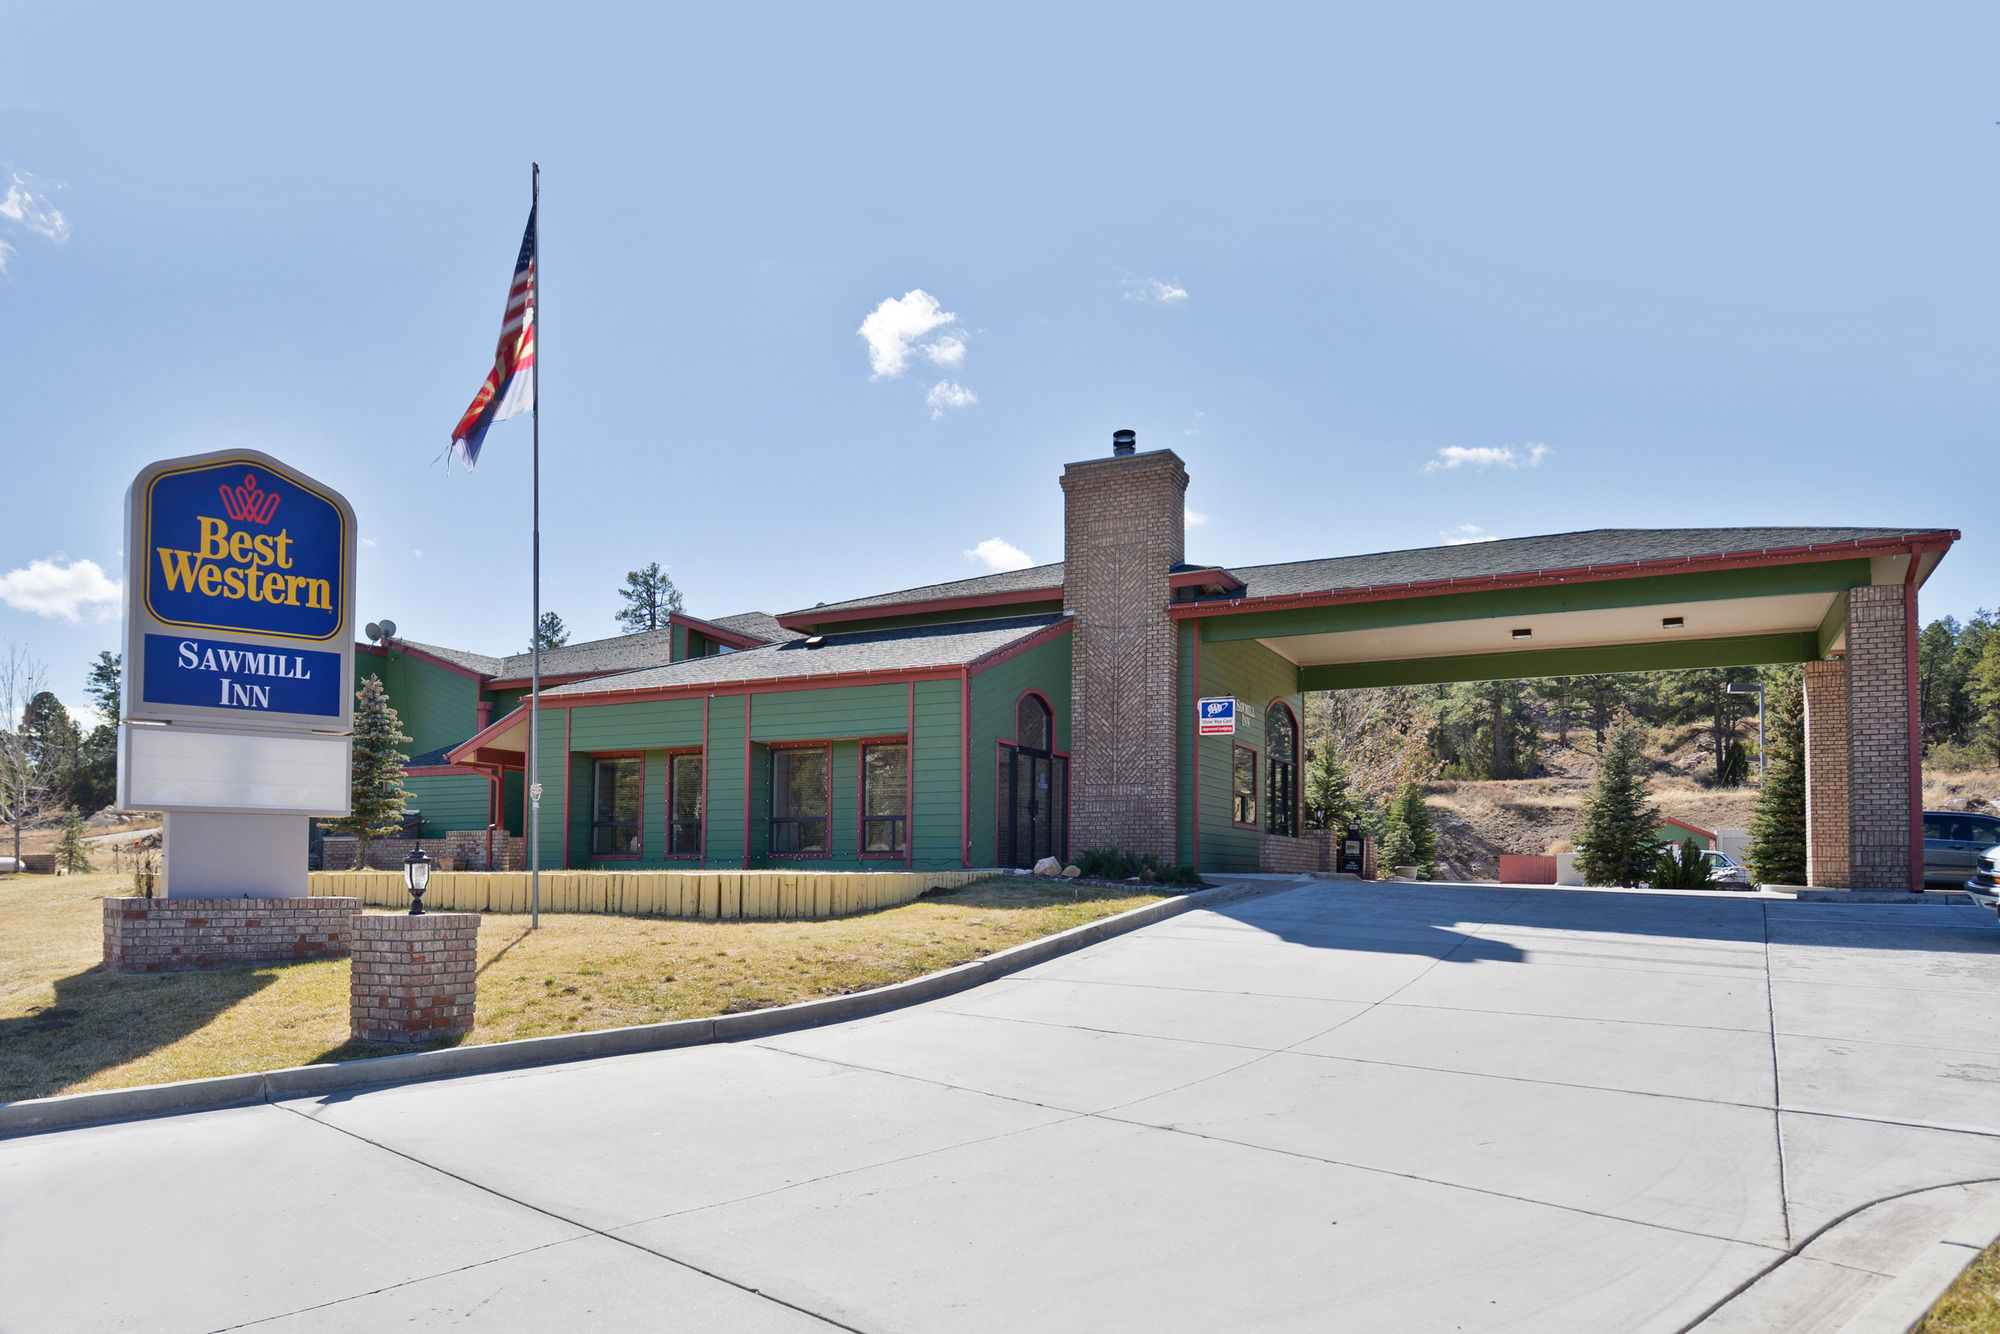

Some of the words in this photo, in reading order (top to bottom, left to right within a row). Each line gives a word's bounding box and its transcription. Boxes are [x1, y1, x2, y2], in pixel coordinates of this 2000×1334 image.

[197, 515, 293, 569] Best
[156, 547, 333, 611] Western
[178, 641, 311, 680] SAWMILL
[219, 678, 271, 709] INN
